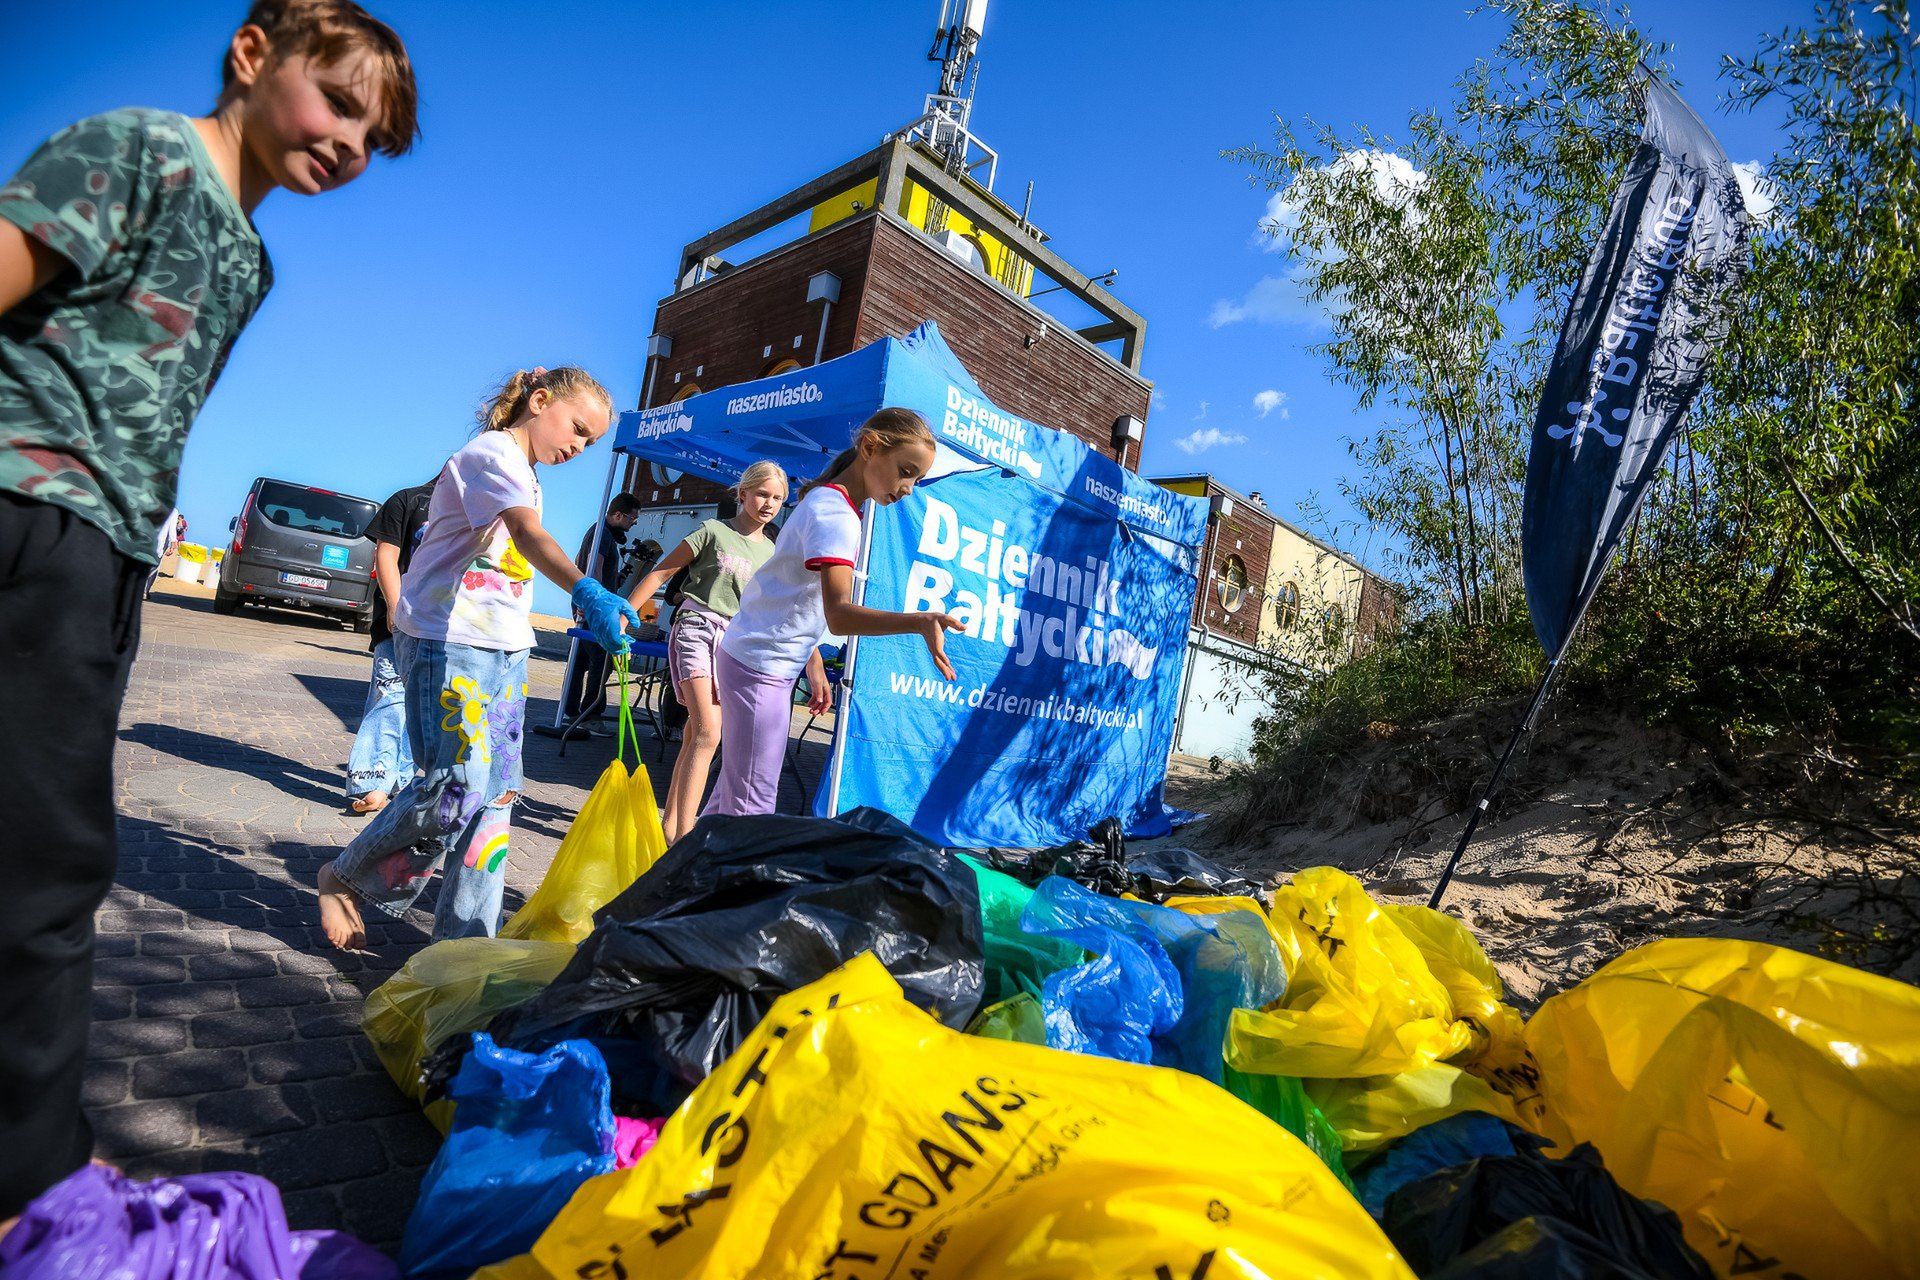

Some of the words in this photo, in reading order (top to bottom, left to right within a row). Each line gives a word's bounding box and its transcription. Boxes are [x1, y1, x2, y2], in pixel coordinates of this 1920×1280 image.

[637, 413, 678, 440] Bałtycki
[942, 409, 1018, 468] Bałtycki
[946, 384, 1027, 446] Dziennik
[917, 494, 1122, 617] Dziennik
[903, 560, 1105, 667] Bałtycki
[859, 1077, 1039, 1230] GDANS
